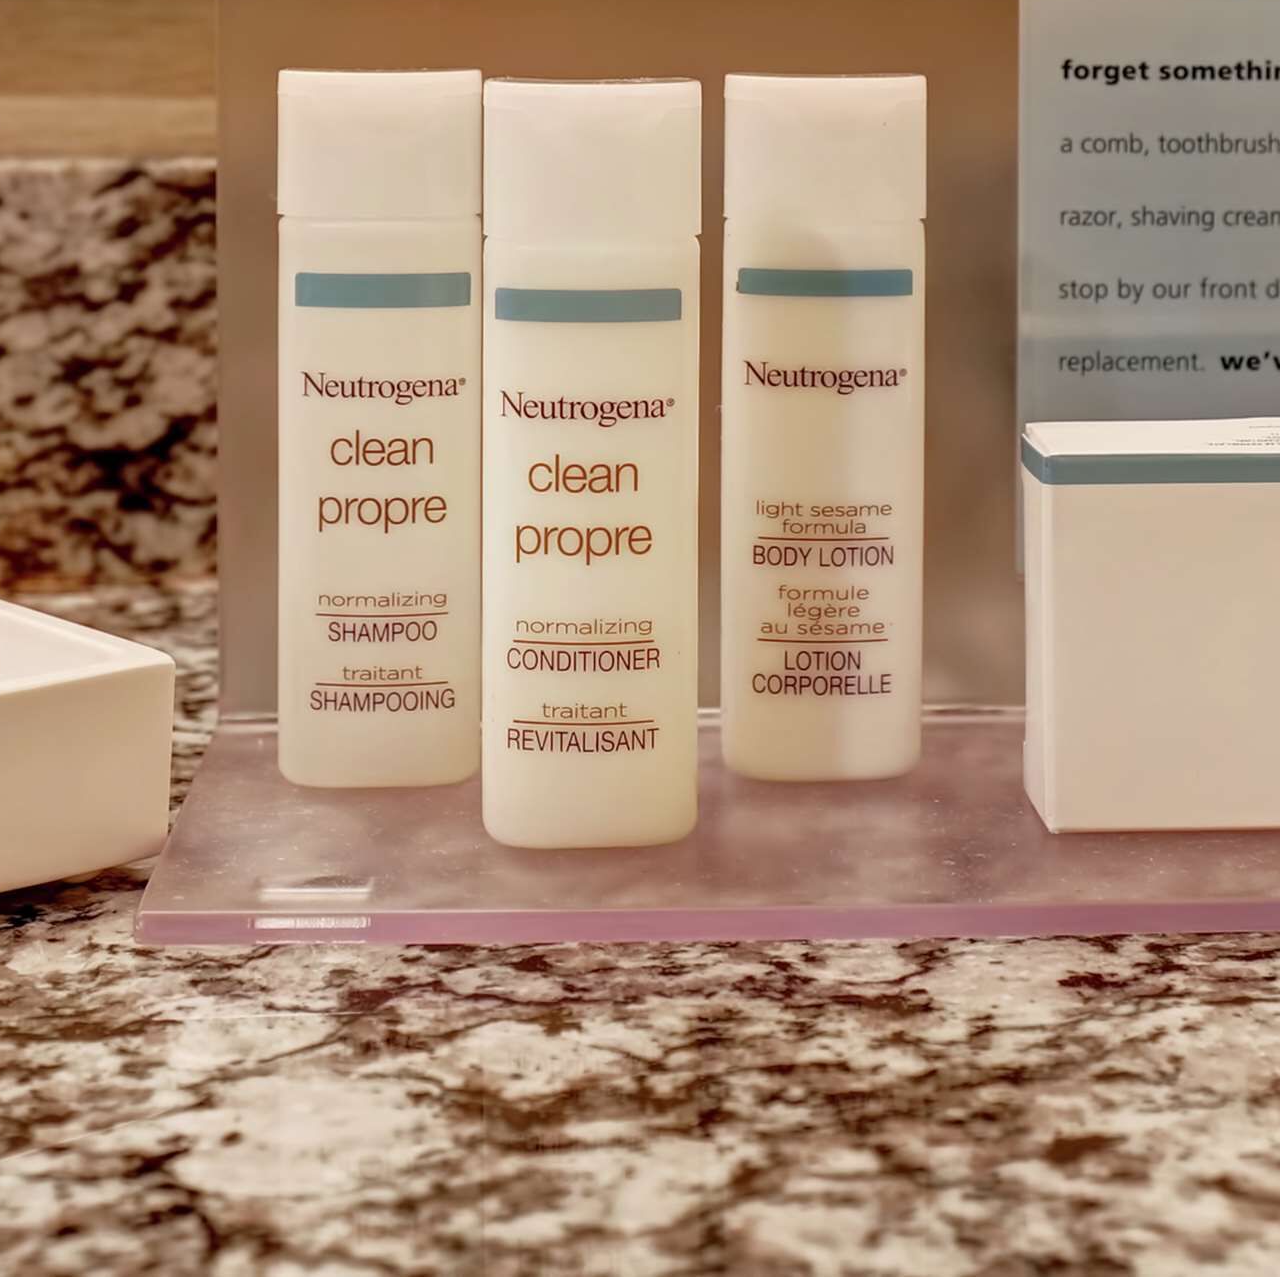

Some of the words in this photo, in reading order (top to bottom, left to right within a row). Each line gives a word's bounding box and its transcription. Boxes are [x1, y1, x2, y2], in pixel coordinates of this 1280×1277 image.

[1061, 59, 1149, 86] forget
[1060, 137, 1073, 154] a
[1080, 132, 1149, 157] comb,
[1060, 210, 1122, 229] razor,
[1131, 205, 1215, 232] shaving
[1059, 280, 1109, 304] stop
[1117, 278, 1144, 304] by
[1151, 283, 1191, 300] our
[1200, 277, 1257, 300] front
[1058, 350, 1205, 376] replacement.
[330, 430, 434, 466] clean
[528, 454, 638, 494] clean
[318, 495, 448, 534] propre
[755, 499, 803, 519] light
[809, 501, 893, 518] sesame
[782, 519, 867, 535] formula
[515, 525, 653, 566] propre
[753, 544, 812, 567] BODY
[819, 545, 894, 567] LOTION
[317, 590, 449, 608] normalizing
[777, 584, 870, 601] formule
[786, 601, 861, 621] légère
[327, 619, 438, 643] SHAMPOO
[515, 617, 654, 635] normalizing
[760, 621, 791, 635] au
[798, 619, 885, 635] sésame
[506, 647, 661, 672] CONDITIONER
[784, 650, 861, 672] LOTION
[342, 664, 423, 681] traitant
[751, 672, 892, 696] CORPORELLE
[309, 688, 456, 712] SHAMPOOING
[542, 701, 627, 719] traitant
[506, 727, 659, 753] REVITALISANT
